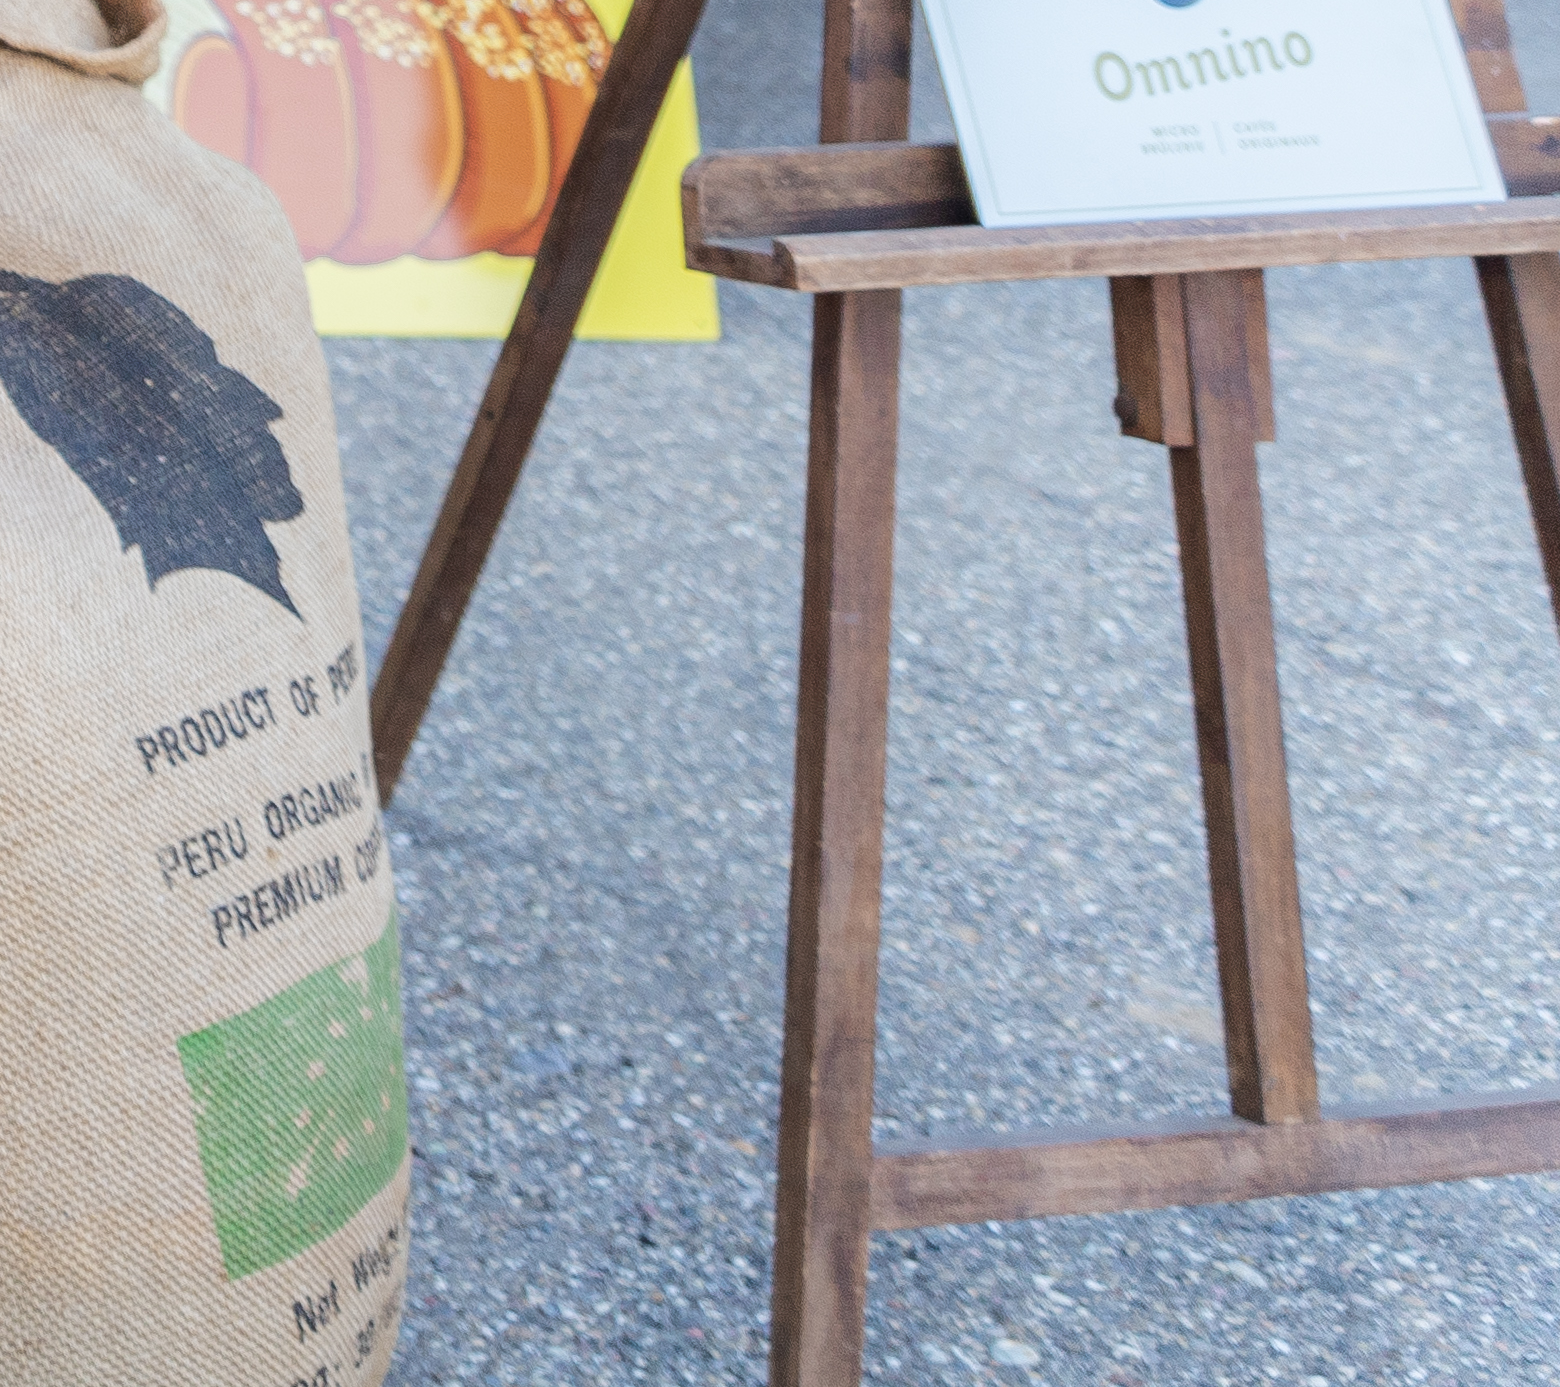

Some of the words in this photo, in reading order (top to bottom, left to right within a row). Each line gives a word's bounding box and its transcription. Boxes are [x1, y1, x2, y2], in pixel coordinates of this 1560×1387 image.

[1092, 27, 1314, 103] Omnino
[135, 686, 277, 776] PRODUCT
[288, 674, 322, 718] OF
[156, 816, 249, 892] PERU
[209, 854, 348, 949] PREMIUM
